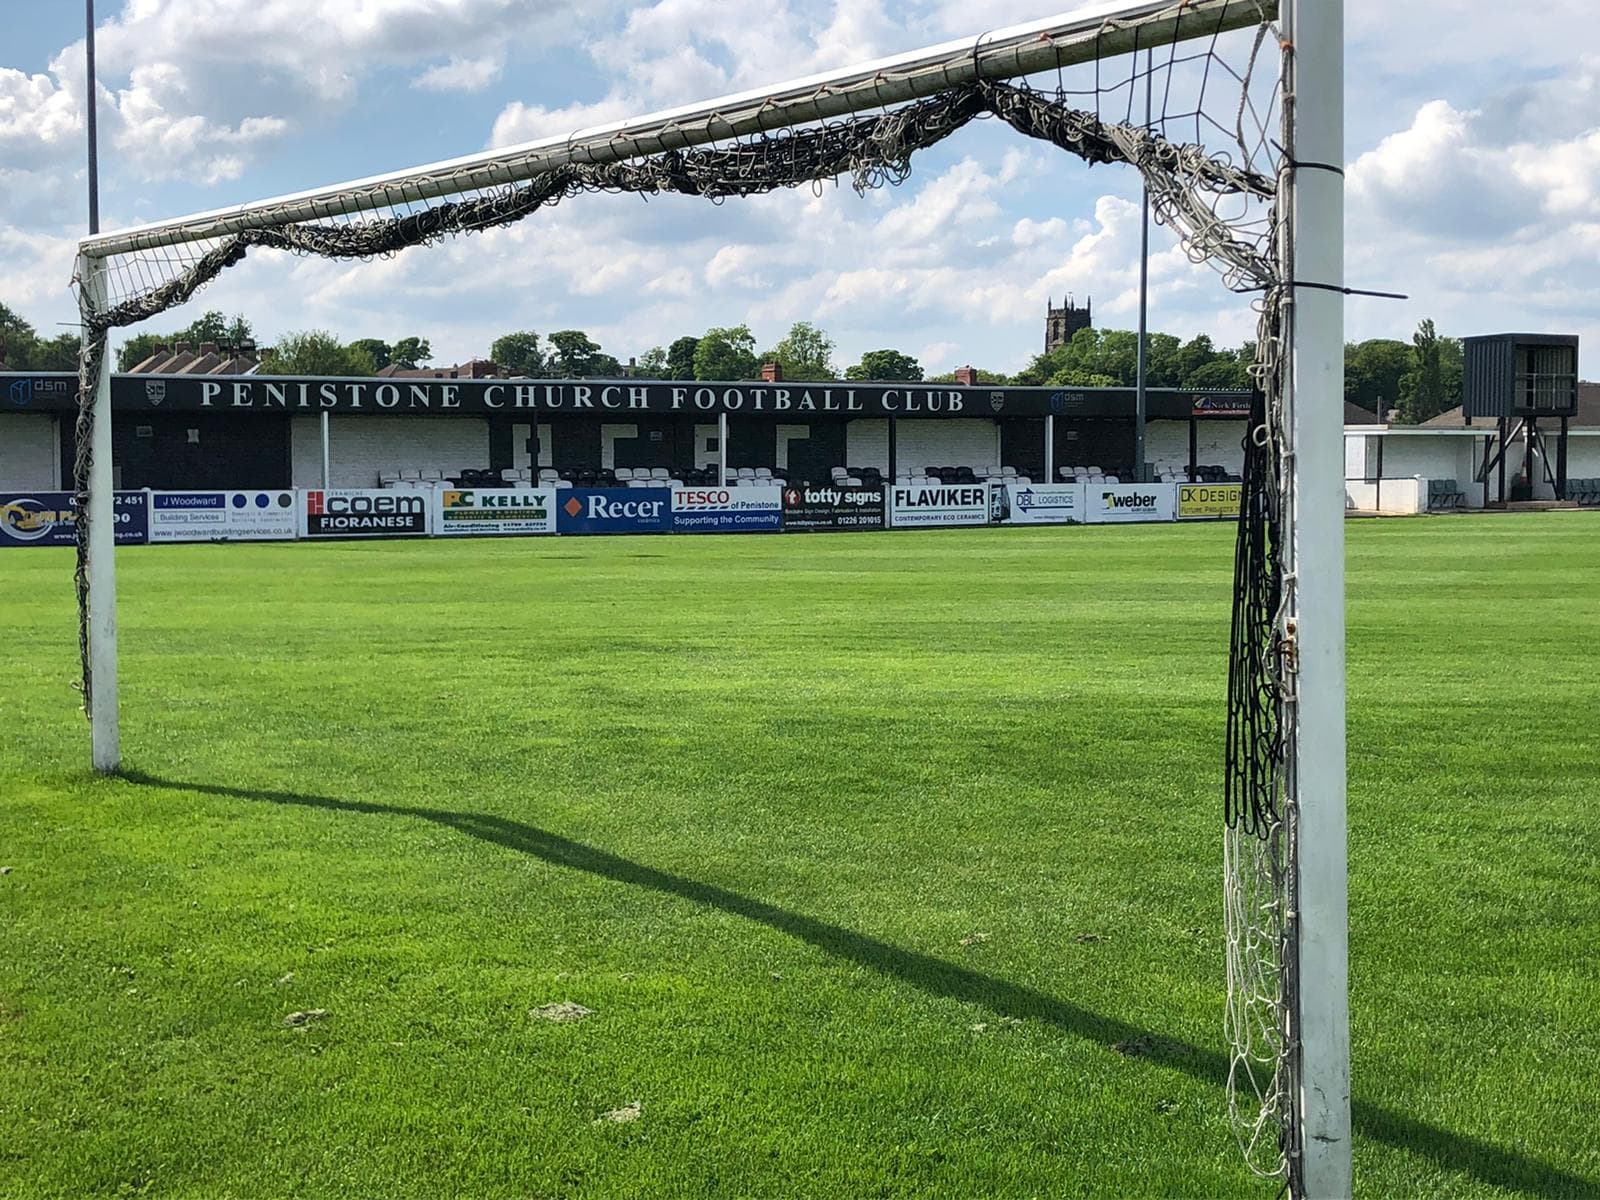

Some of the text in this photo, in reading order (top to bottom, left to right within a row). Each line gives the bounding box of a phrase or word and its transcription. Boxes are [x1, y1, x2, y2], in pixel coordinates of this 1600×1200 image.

[34, 379, 67, 391] dsm
[200, 381, 964, 412] PENISTONE CHURCH FOOTBALL CLUB
[125, 496, 143, 505] 451
[482, 495, 547, 507] KELLY
[674, 490, 730, 504] TESCO
[804, 488, 842, 506] totty
[845, 489, 882, 506] signs
[895, 489, 985, 507] FLAVIKER
[1016, 495, 1074, 506] DBL LOGISTICS
[1113, 492, 1157, 507] weber
[1181, 488, 1242, 502] DK DESIG
[163, 497, 217, 506] J Woodward
[327, 496, 425, 514] coem
[586, 495, 664, 519] Recer
[731, 501, 779, 510] of Penistone
[160, 512, 219, 523] Building Services
[320, 516, 414, 528] FIORANESE
[674, 516, 719, 526] Supporting
[735, 515, 779, 524] Community
[895, 514, 942, 522] CONTEMPORARY
